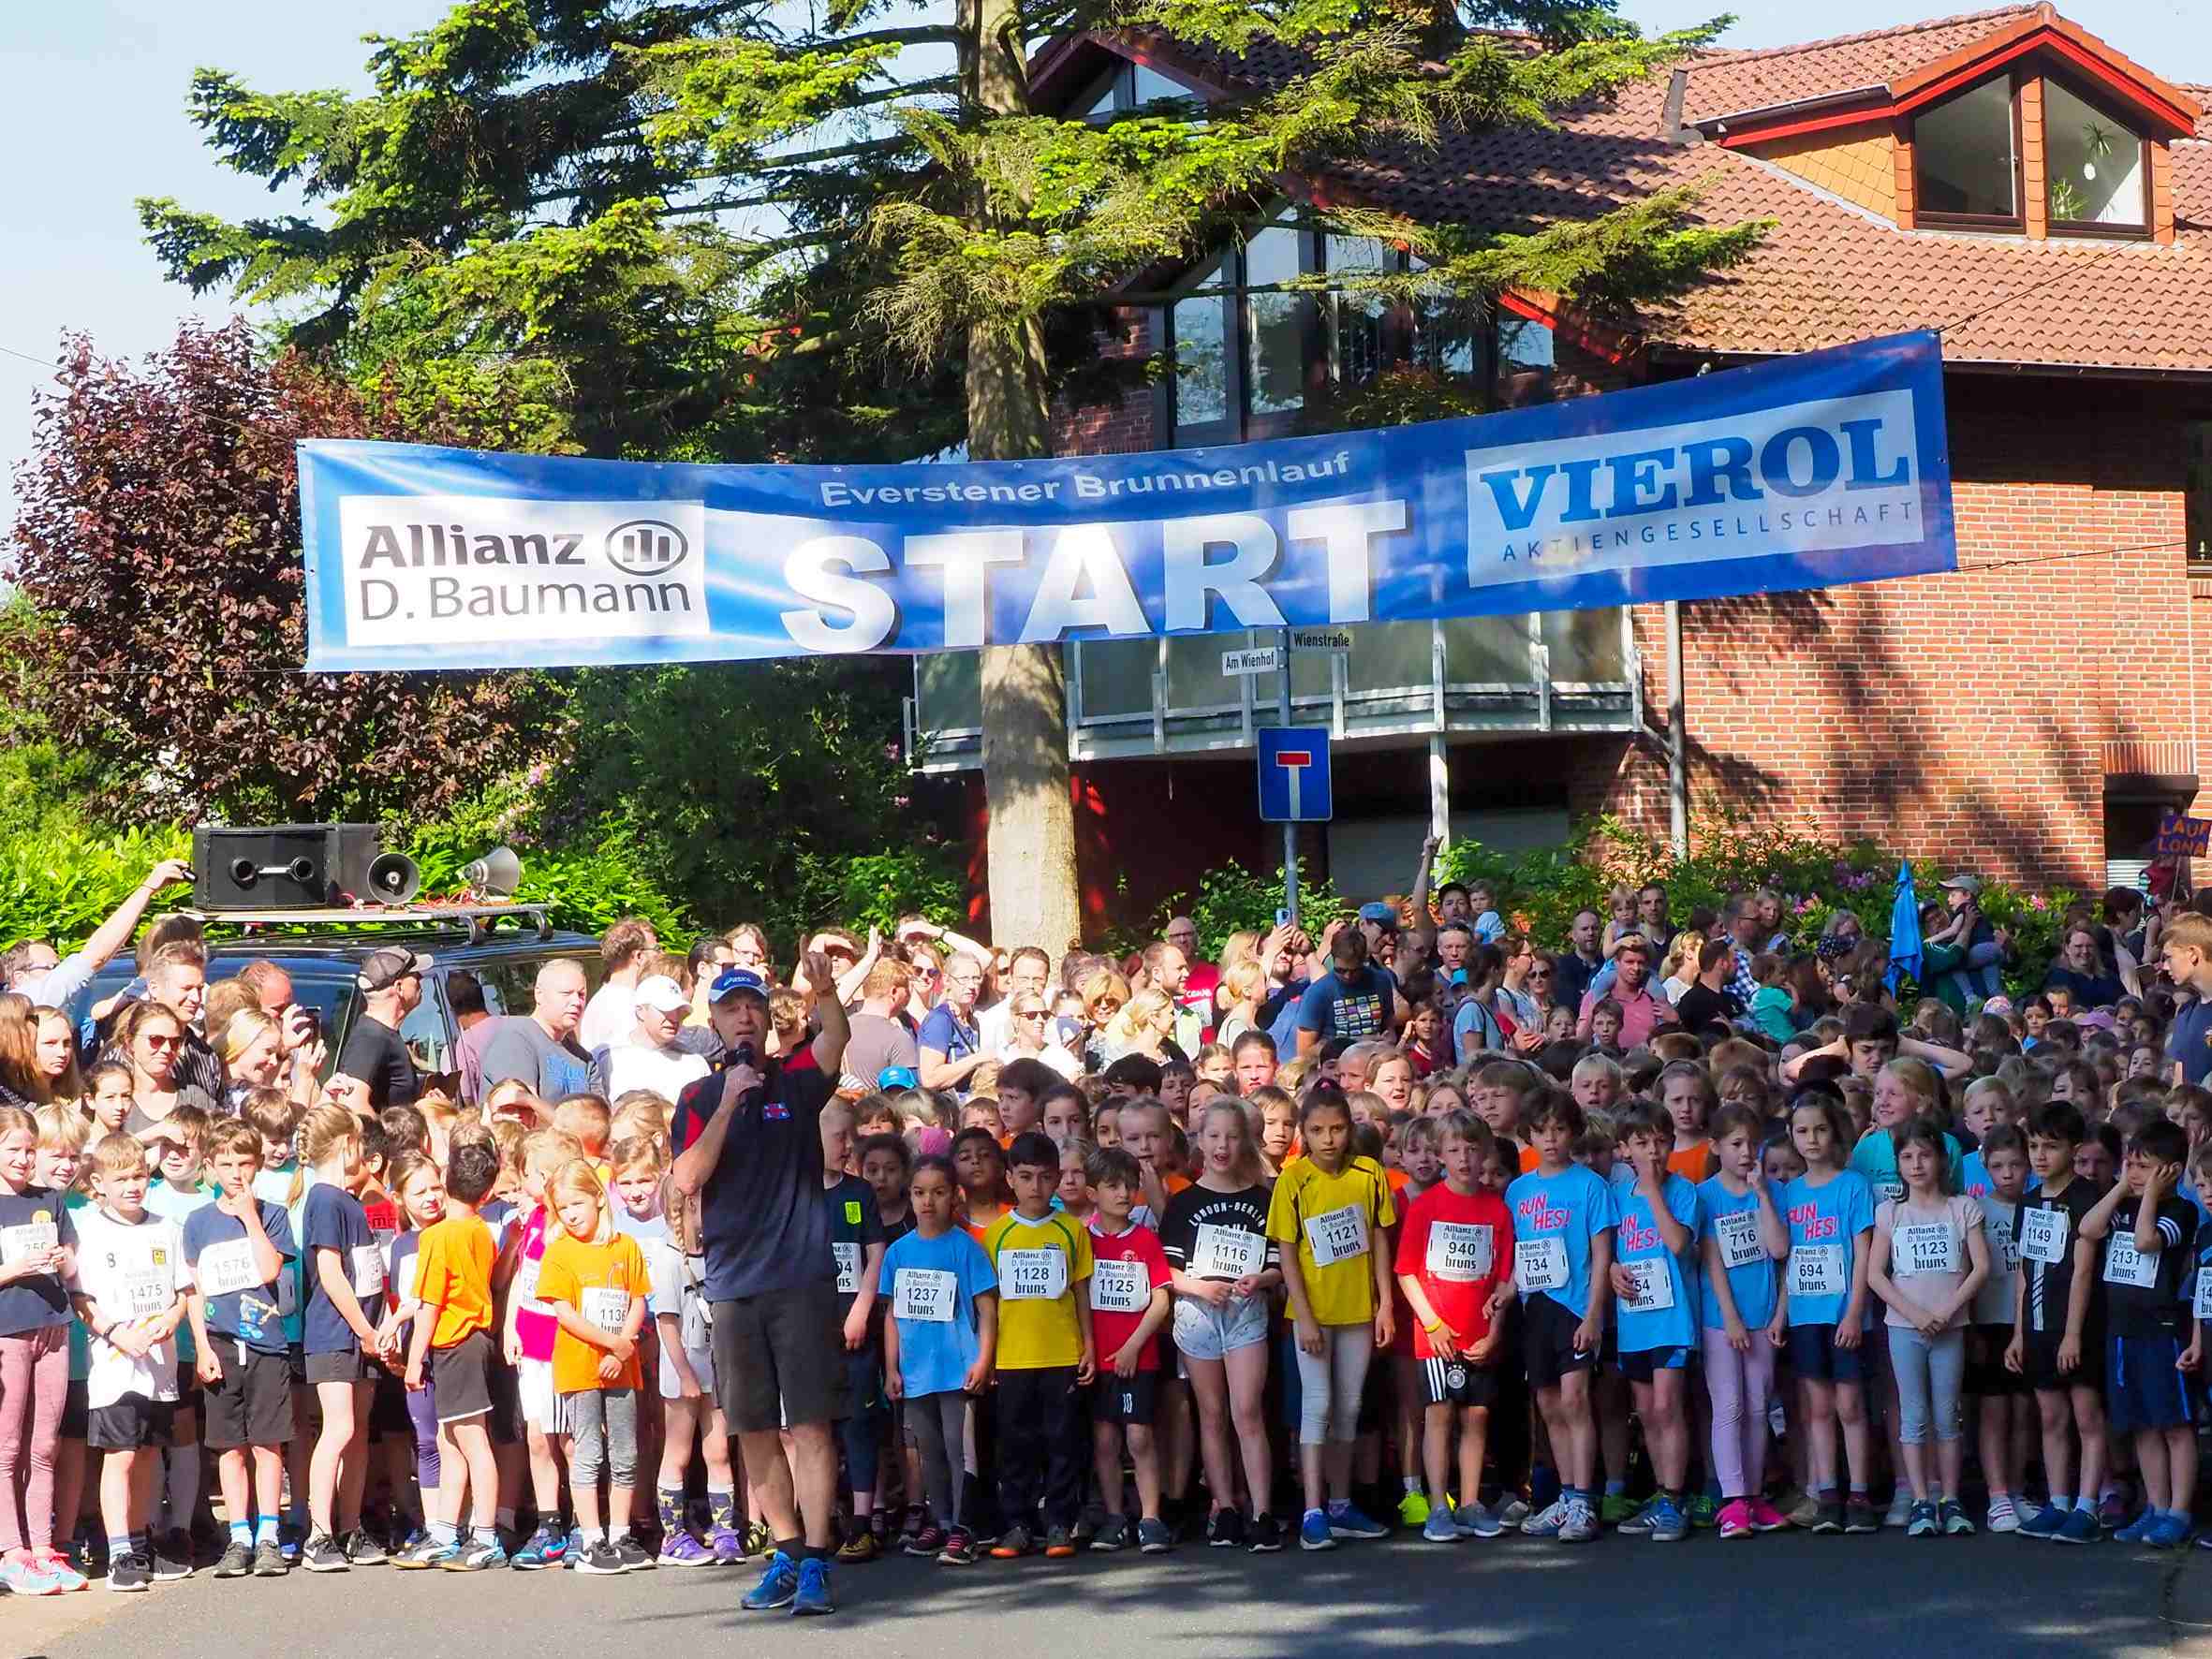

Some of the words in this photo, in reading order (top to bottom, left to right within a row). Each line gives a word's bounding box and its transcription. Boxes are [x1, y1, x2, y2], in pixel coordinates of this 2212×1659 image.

[820, 479, 1062, 507] Everstener
[1074, 450, 1351, 498] Brunnenlauf
[1479, 418, 1910, 531] VIEROL
[1502, 501, 1913, 563] AKTIENGESELLSCHAFT
[359, 523, 585, 569] Allianz
[779, 499, 1407, 653] START
[361, 580, 414, 622] D.
[429, 577, 691, 619] Baumann
[1293, 632, 1349, 648] Wienstraße
[1226, 656, 1239, 671] Am
[1241, 652, 1275, 668] Wienhof
[1188, 1201, 1266, 1227] LONDON-BERLIN
[1519, 1194, 1548, 1217] RUN
[1533, 1209, 1571, 1231] HES!
[1618, 1212, 1637, 1237] UN
[1326, 1223, 1358, 1244] 1121
[1730, 1229, 1757, 1247] 716
[2028, 1227, 2051, 1242] 1149
[1214, 1243, 1248, 1262] 1116
[1332, 1240, 1361, 1257] bruns
[1449, 1241, 1476, 1255] 940
[1731, 1245, 1761, 1260] bruns
[1911, 1241, 1948, 1255] 1123
[1212, 1256, 1244, 1274] bruns
[1445, 1255, 1477, 1270] bruns
[1525, 1257, 1548, 1271] 734
[1913, 1257, 1947, 1270] bruns
[2112, 1249, 2141, 1266] 2131
[1013, 1268, 1049, 1280] 1128
[1525, 1272, 1552, 1286] bruns
[1799, 1264, 1824, 1277] 694
[2112, 1263, 2137, 1280] bruns
[1014, 1281, 1047, 1294] bruns
[1099, 1279, 1134, 1293] 1125
[1798, 1278, 1827, 1291] bruns
[907, 1287, 939, 1301] 1237
[1099, 1292, 1131, 1307] bruns
[907, 1300, 935, 1315] bruns
